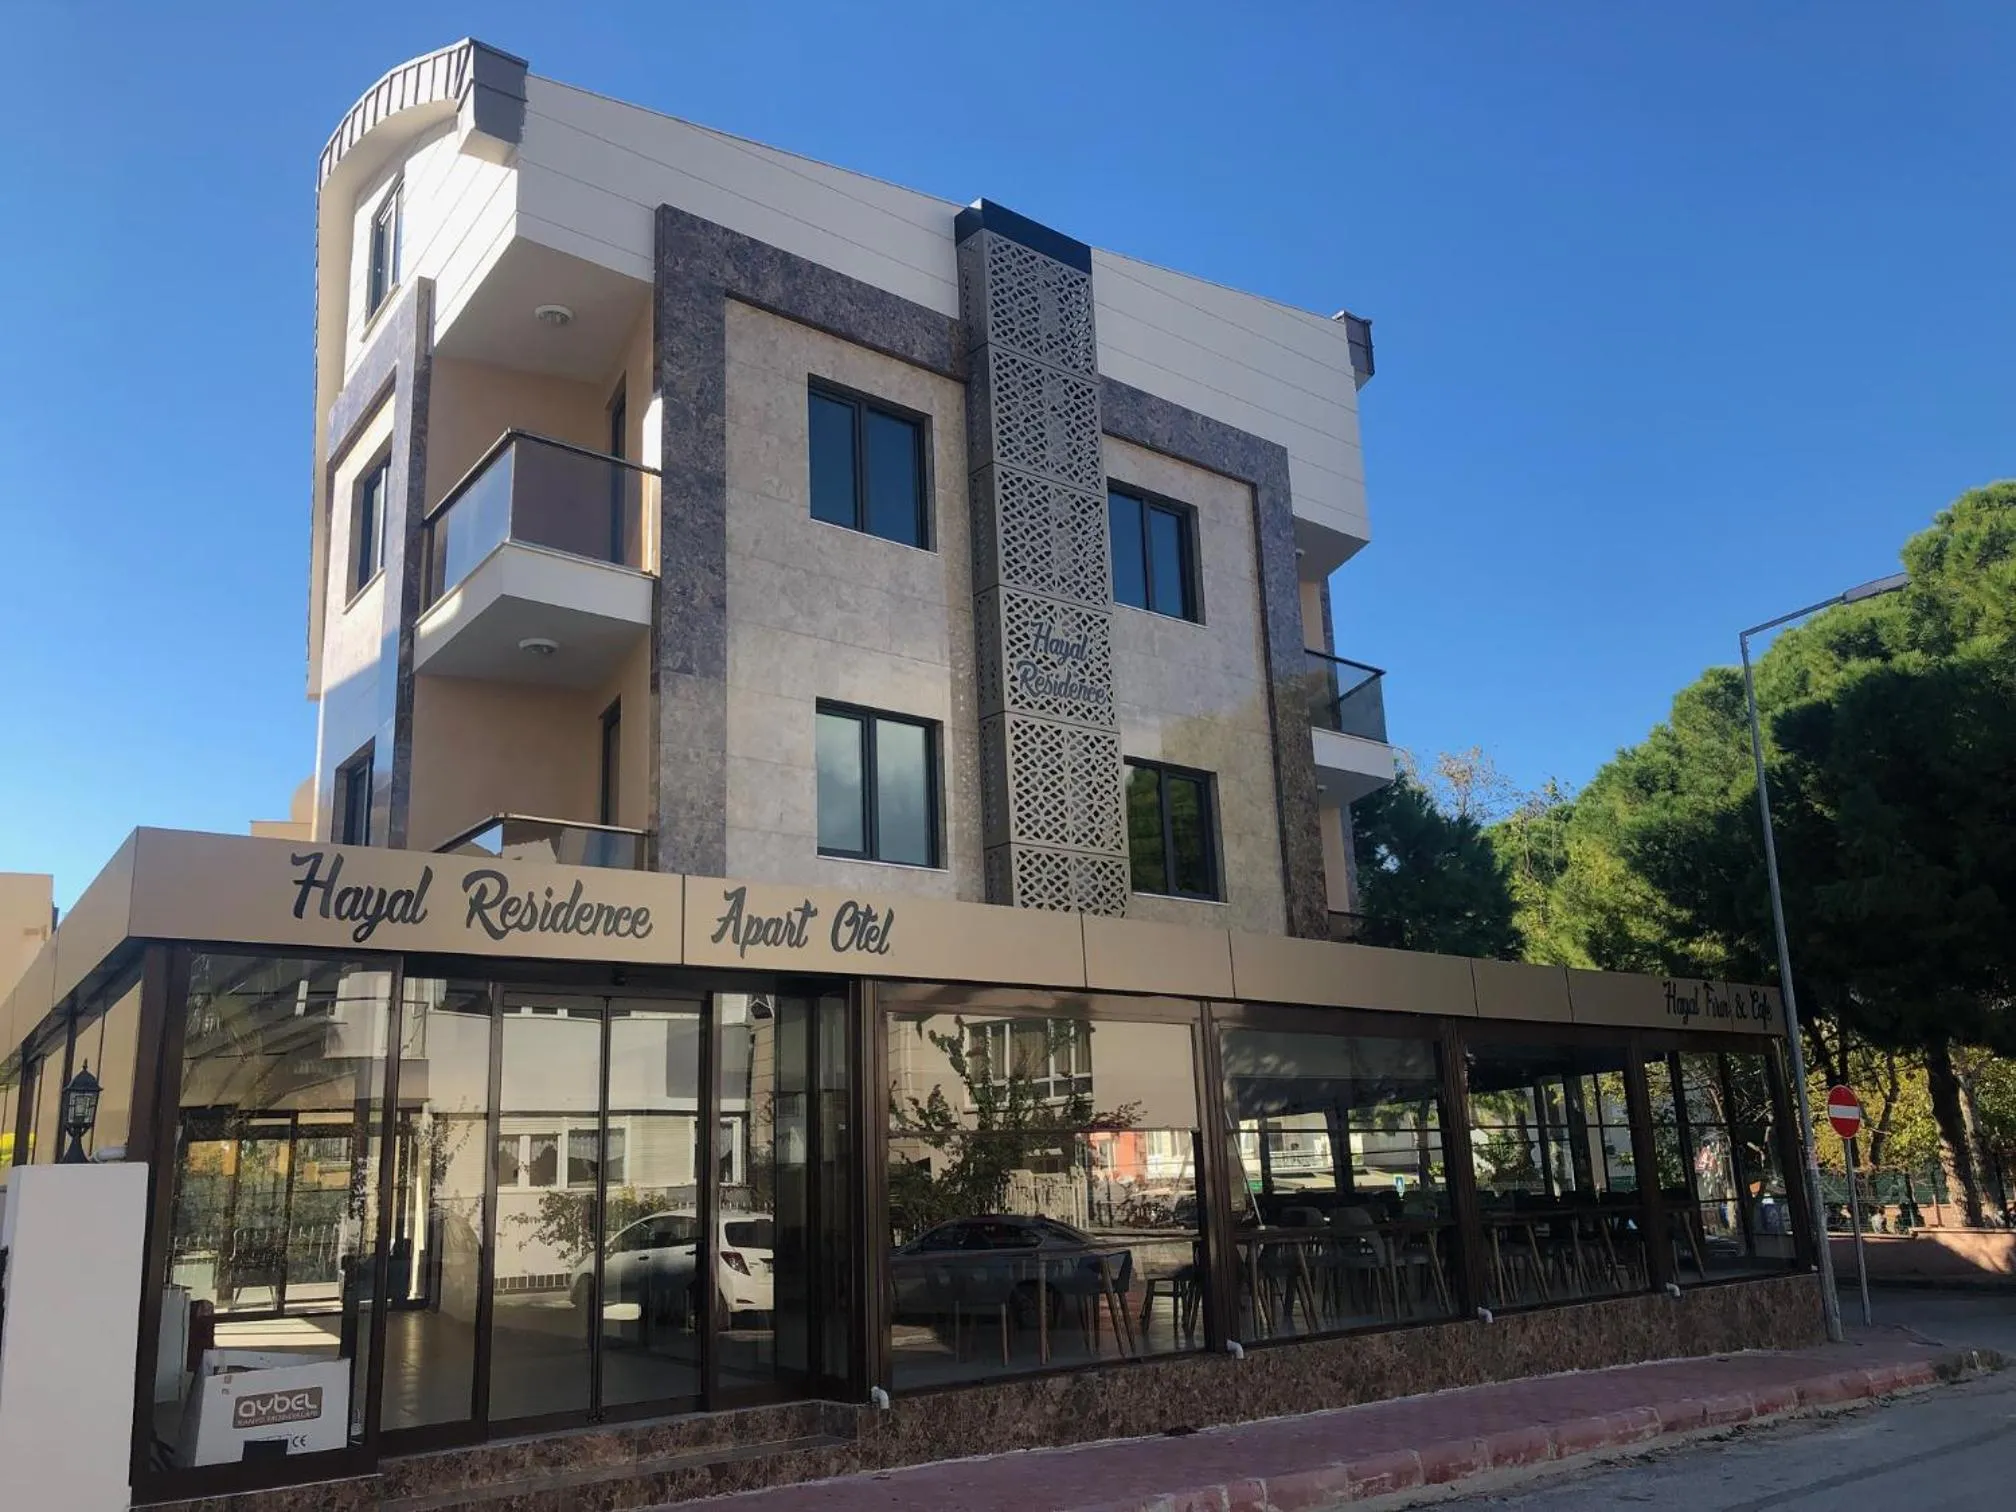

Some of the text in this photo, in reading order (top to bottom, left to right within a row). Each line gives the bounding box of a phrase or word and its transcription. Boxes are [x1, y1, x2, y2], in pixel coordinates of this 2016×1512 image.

[1030, 620, 1089, 665] Hayal
[1016, 659, 1107, 704] Residence
[291, 852, 653, 943] Hayal Residence
[711, 886, 895, 960] Apart Otel
[1662, 980, 1699, 1025] Hayal
[1735, 992, 1747, 1019] &
